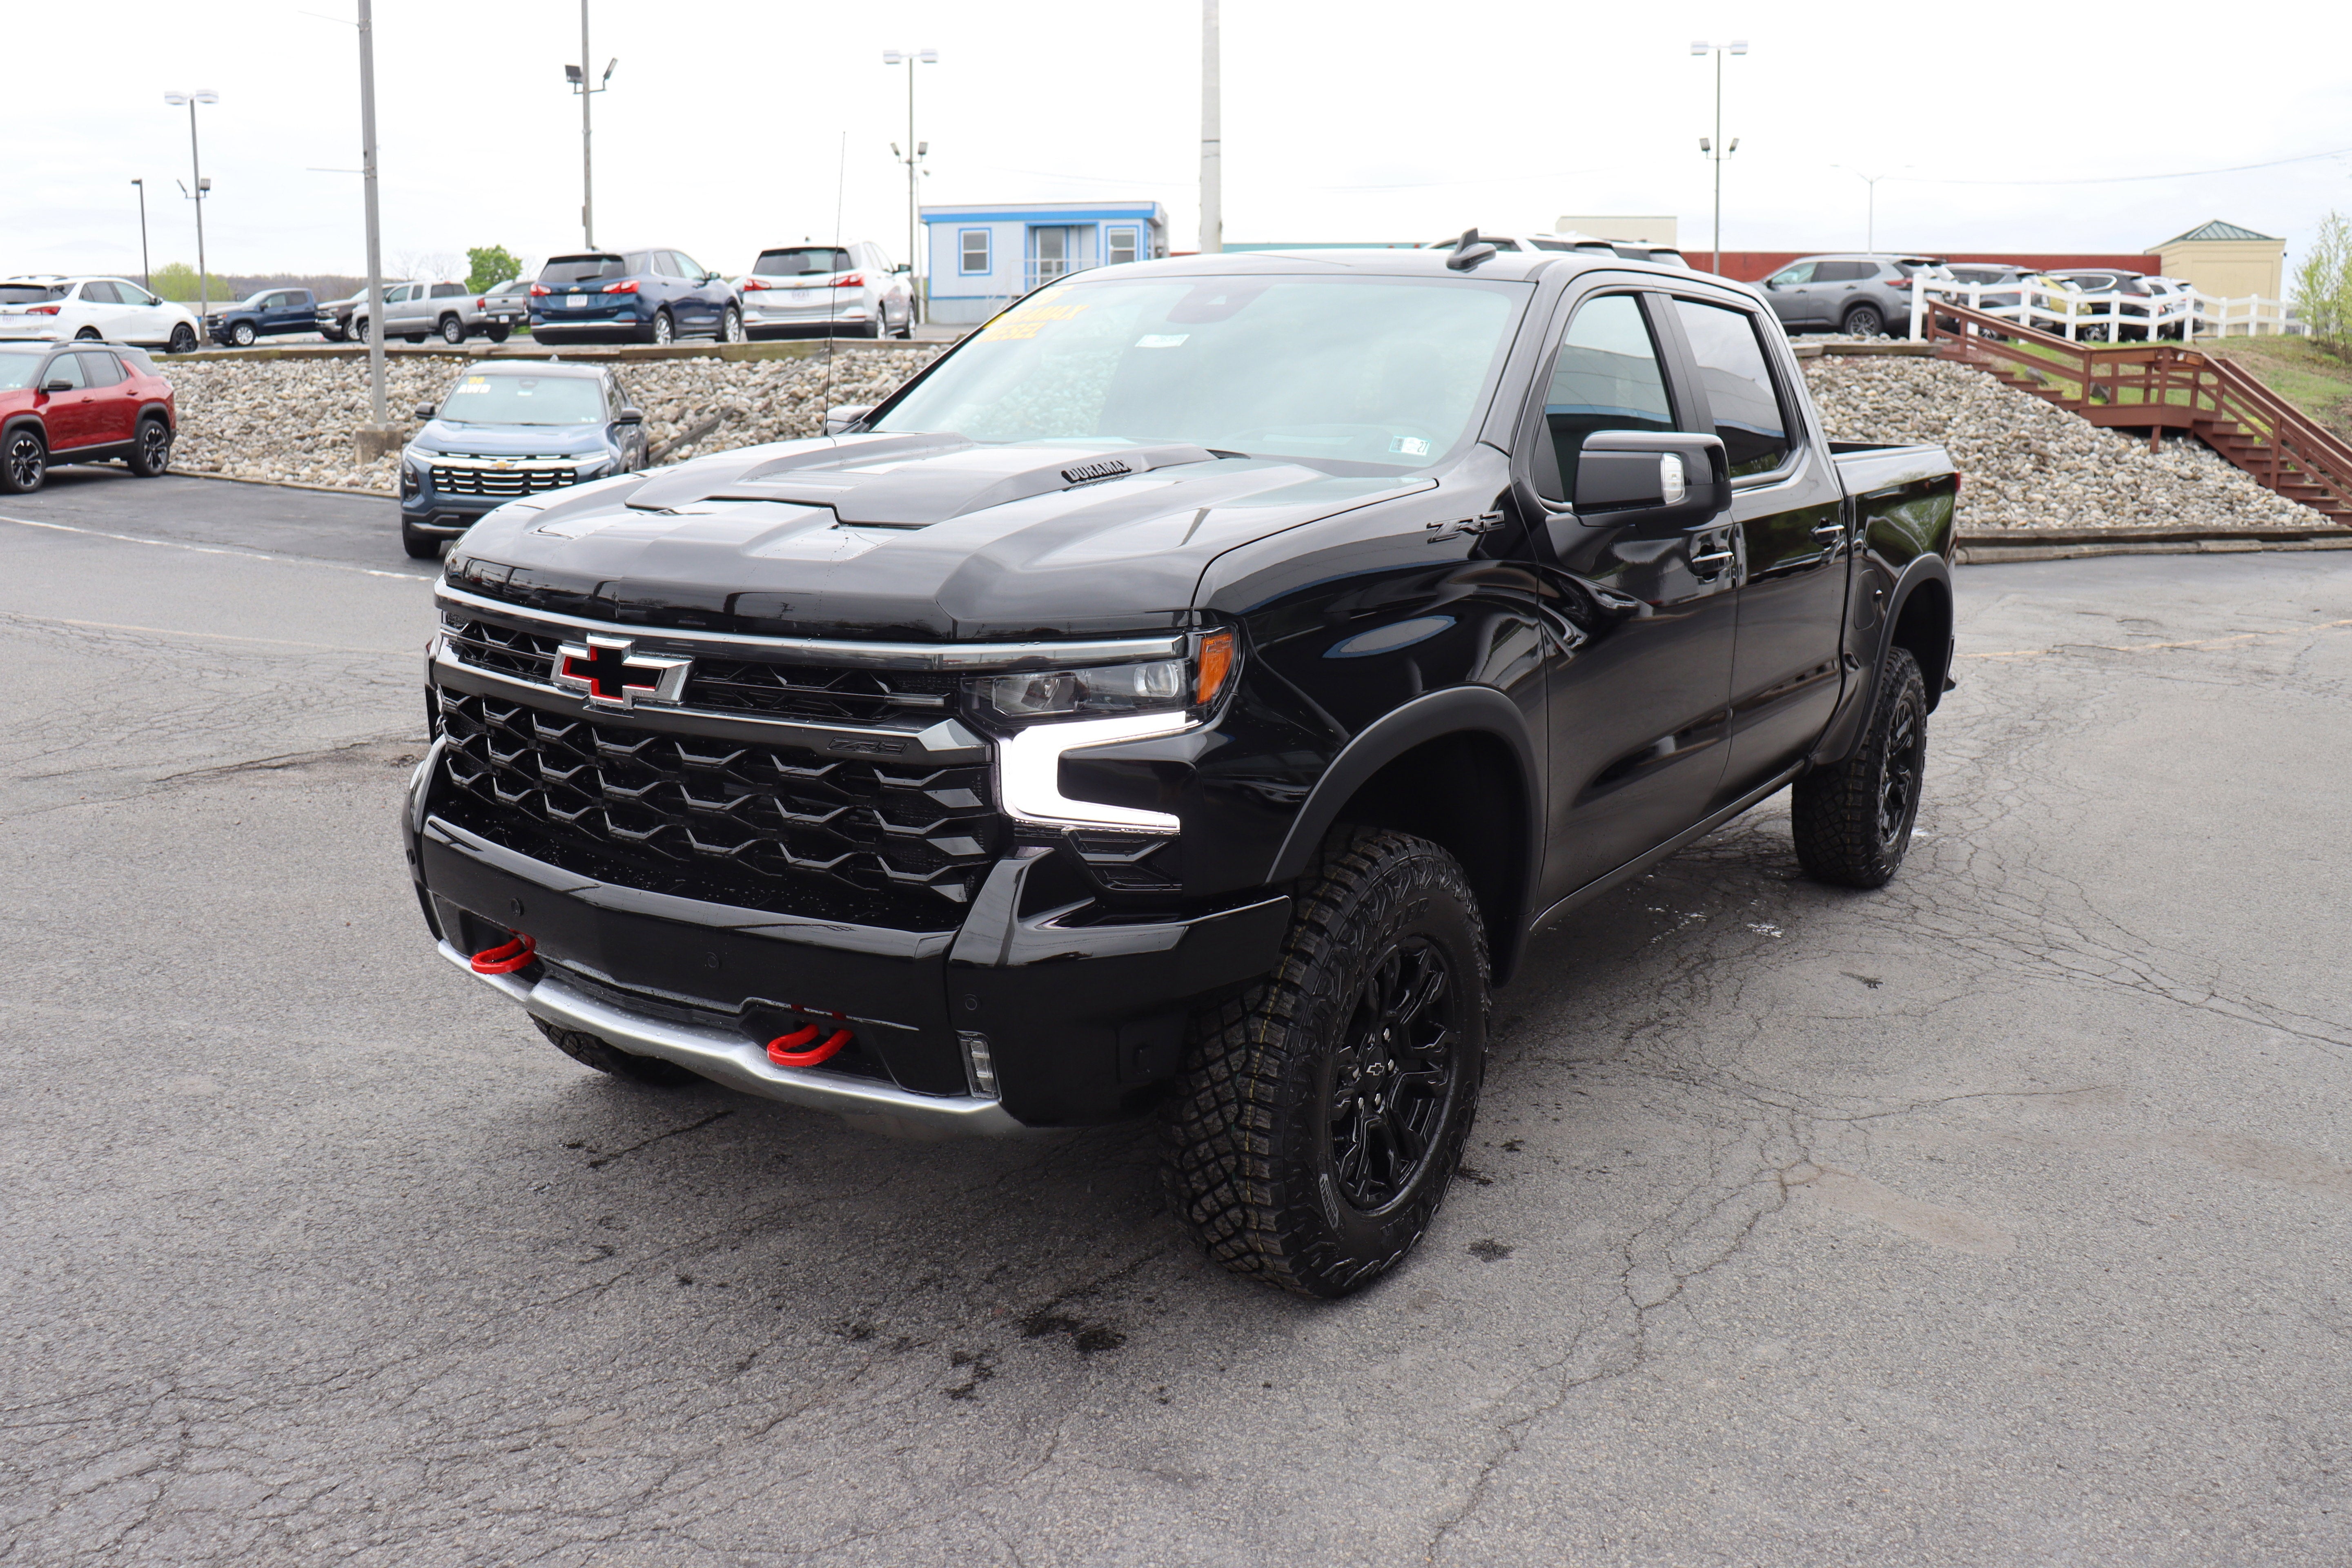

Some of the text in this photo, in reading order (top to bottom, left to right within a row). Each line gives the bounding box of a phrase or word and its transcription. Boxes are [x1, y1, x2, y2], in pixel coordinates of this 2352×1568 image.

[456, 384, 491, 394] AWD
[1417, 441, 1429, 454] 27
[1061, 459, 1133, 483] DURAMAX
[1426, 510, 1506, 544] ZR2
[827, 736, 910, 757] ZR2
